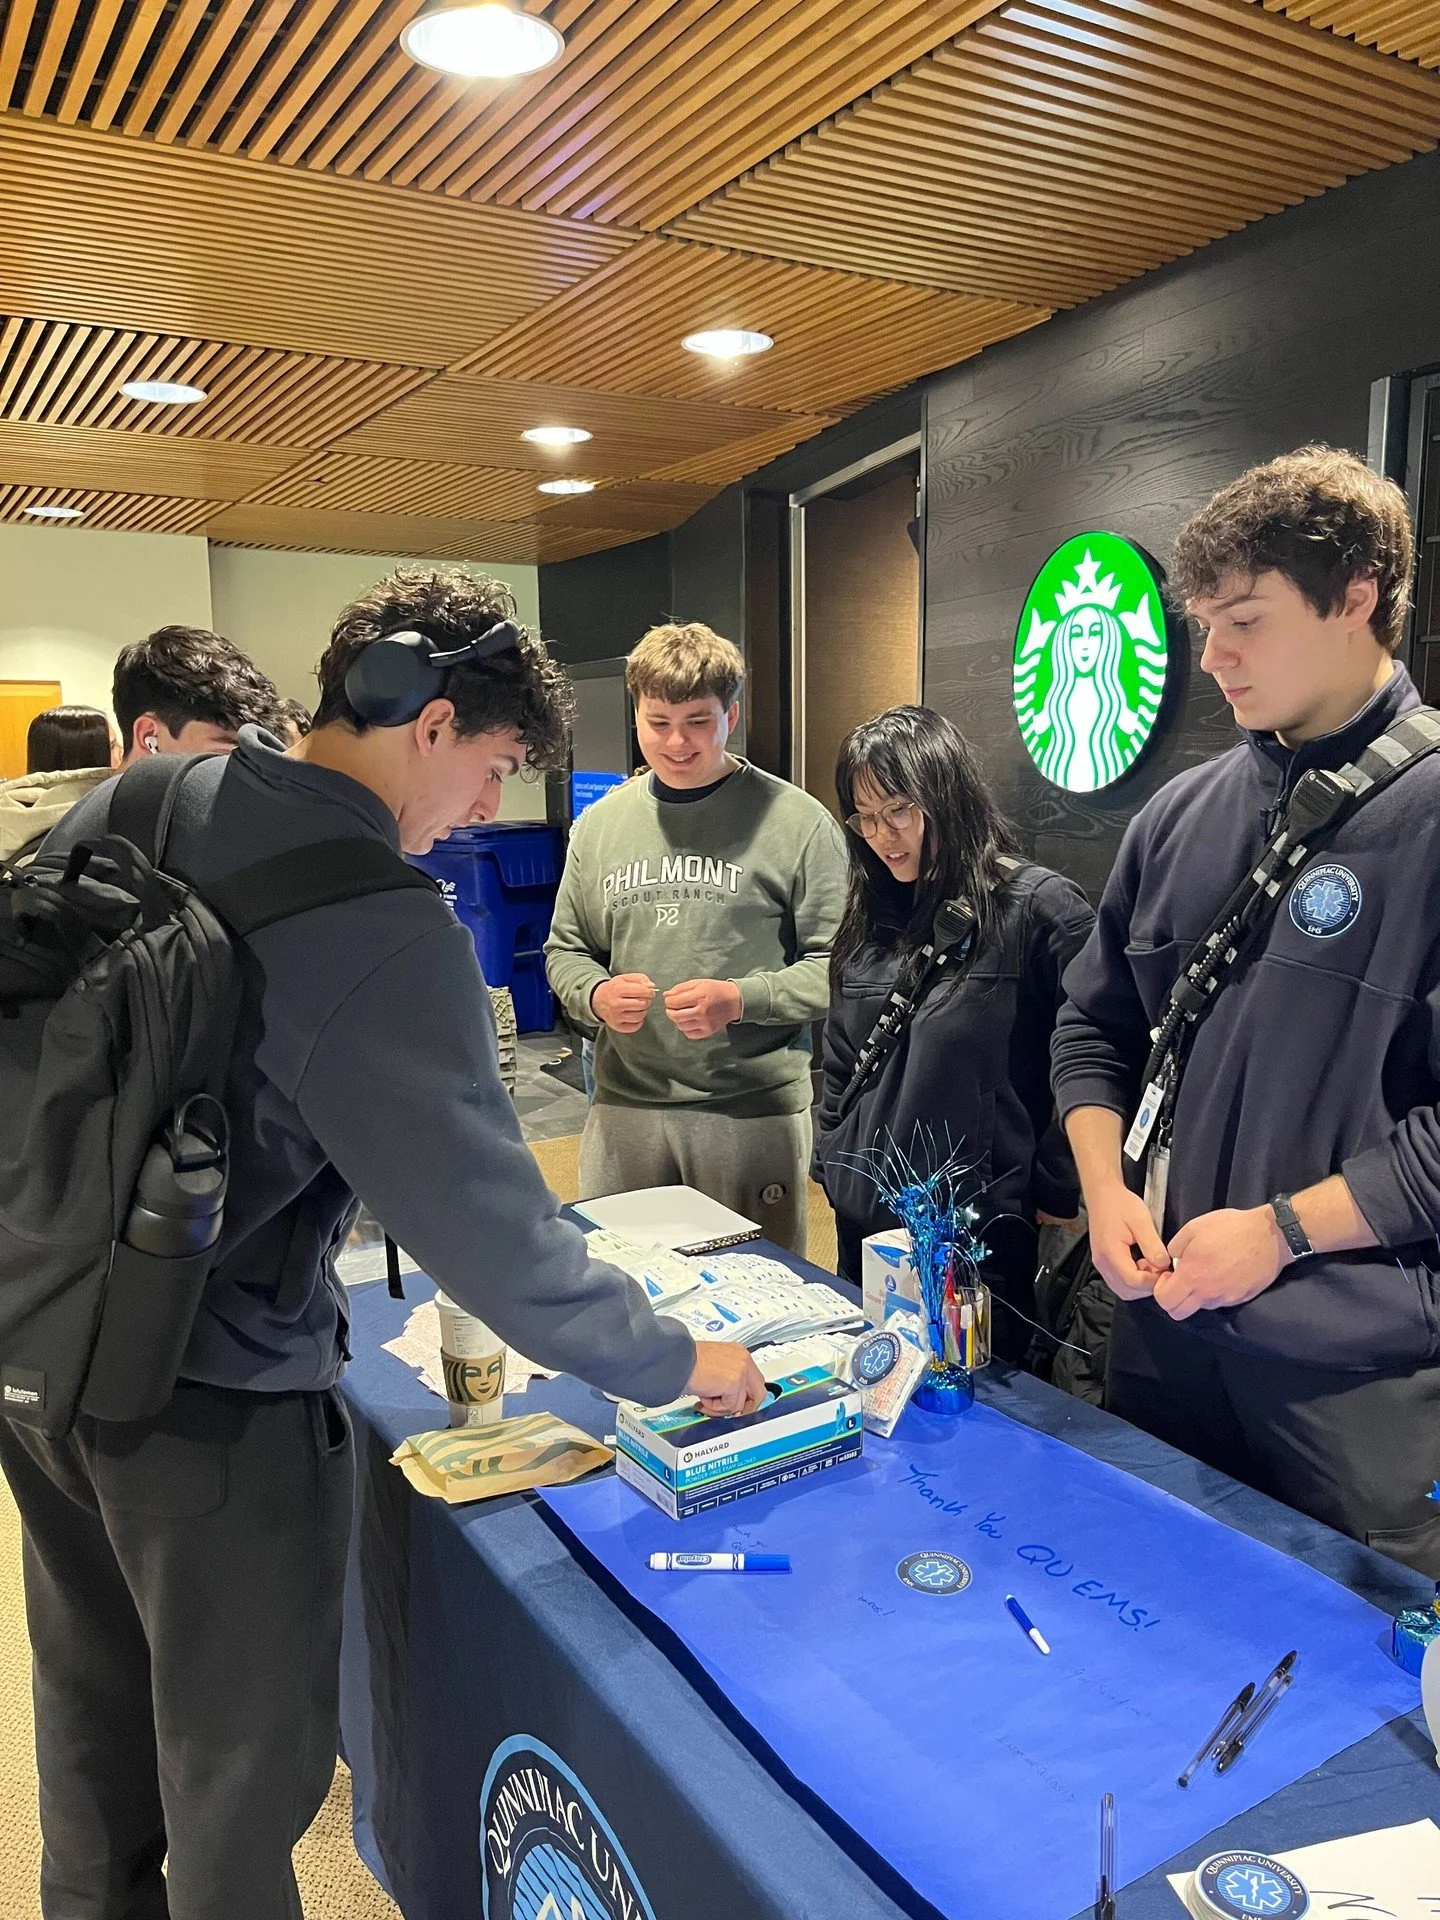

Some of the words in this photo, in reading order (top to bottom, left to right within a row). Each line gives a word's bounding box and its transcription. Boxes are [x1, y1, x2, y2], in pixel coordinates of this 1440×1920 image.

[602, 855, 743, 897] PHILMONT
[1297, 867, 1335, 890] QUINNIPIAC
[1335, 869, 1359, 902] UNIVERSITY
[612, 890, 662, 911] SCOUT
[672, 889, 726, 904] RANCH
[1307, 925, 1322, 934] EMS
[848, 1419, 854, 1429] L
[694, 1442, 730, 1459] HALYARD
[685, 1464, 707, 1479] BLUE
[707, 1454, 740, 1471] NITRILE
[679, 1554, 710, 1565] Crayola
[898, 1464, 968, 1517] Thank
[974, 1511, 1006, 1539] You
[1016, 1544, 1074, 1577] QU
[1072, 1578, 1161, 1632] EMS!
[920, 1552, 960, 1565] QUINNIPIAC
[590, 1826, 643, 1920] UN
[1205, 1855, 1256, 1875] QUINNIPIAC
[1257, 1857, 1304, 1896] UNIVERSITY
